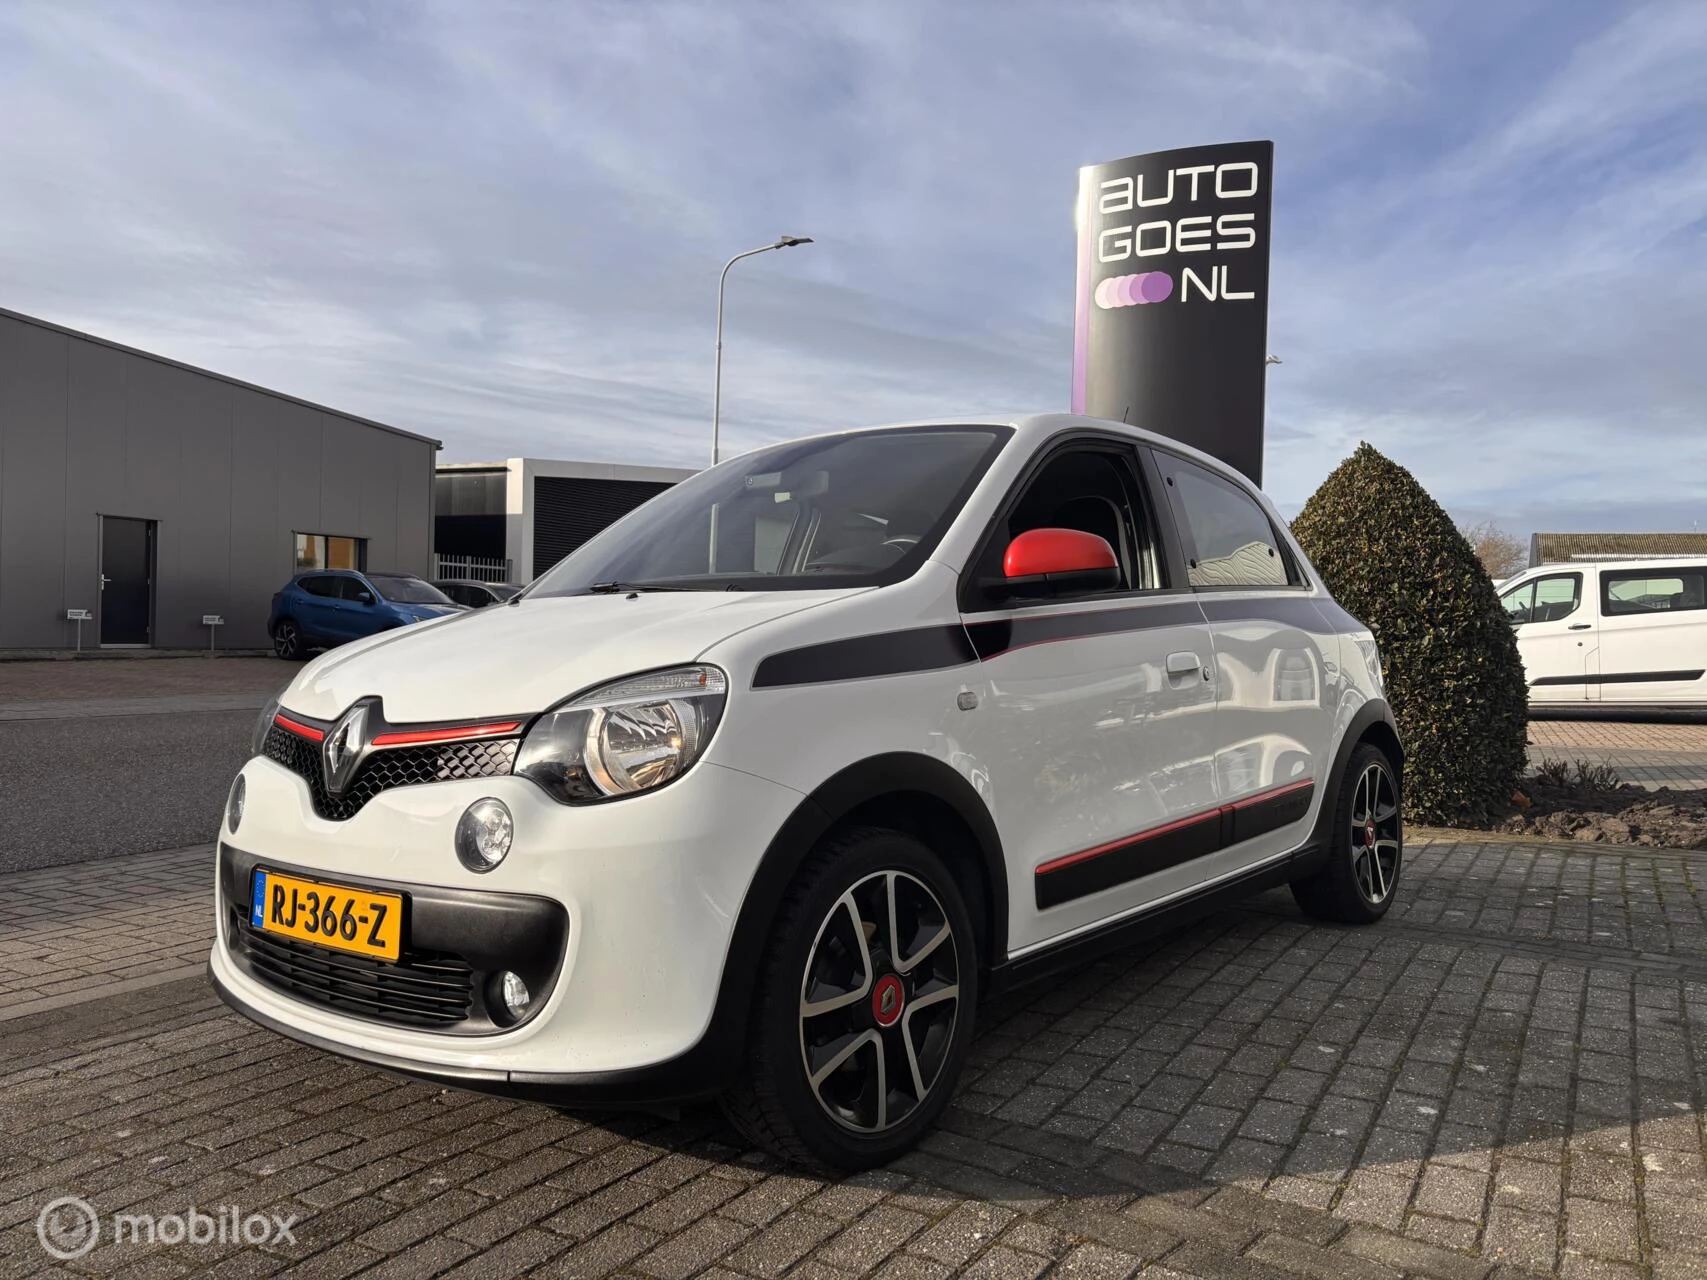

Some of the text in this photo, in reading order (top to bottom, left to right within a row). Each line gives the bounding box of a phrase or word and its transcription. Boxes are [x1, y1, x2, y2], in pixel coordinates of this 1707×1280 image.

[1099, 213, 1256, 263] GOES
[1181, 265, 1256, 302] NL
[255, 904, 264, 917] NL
[271, 884, 388, 948] RJ-366-Z
